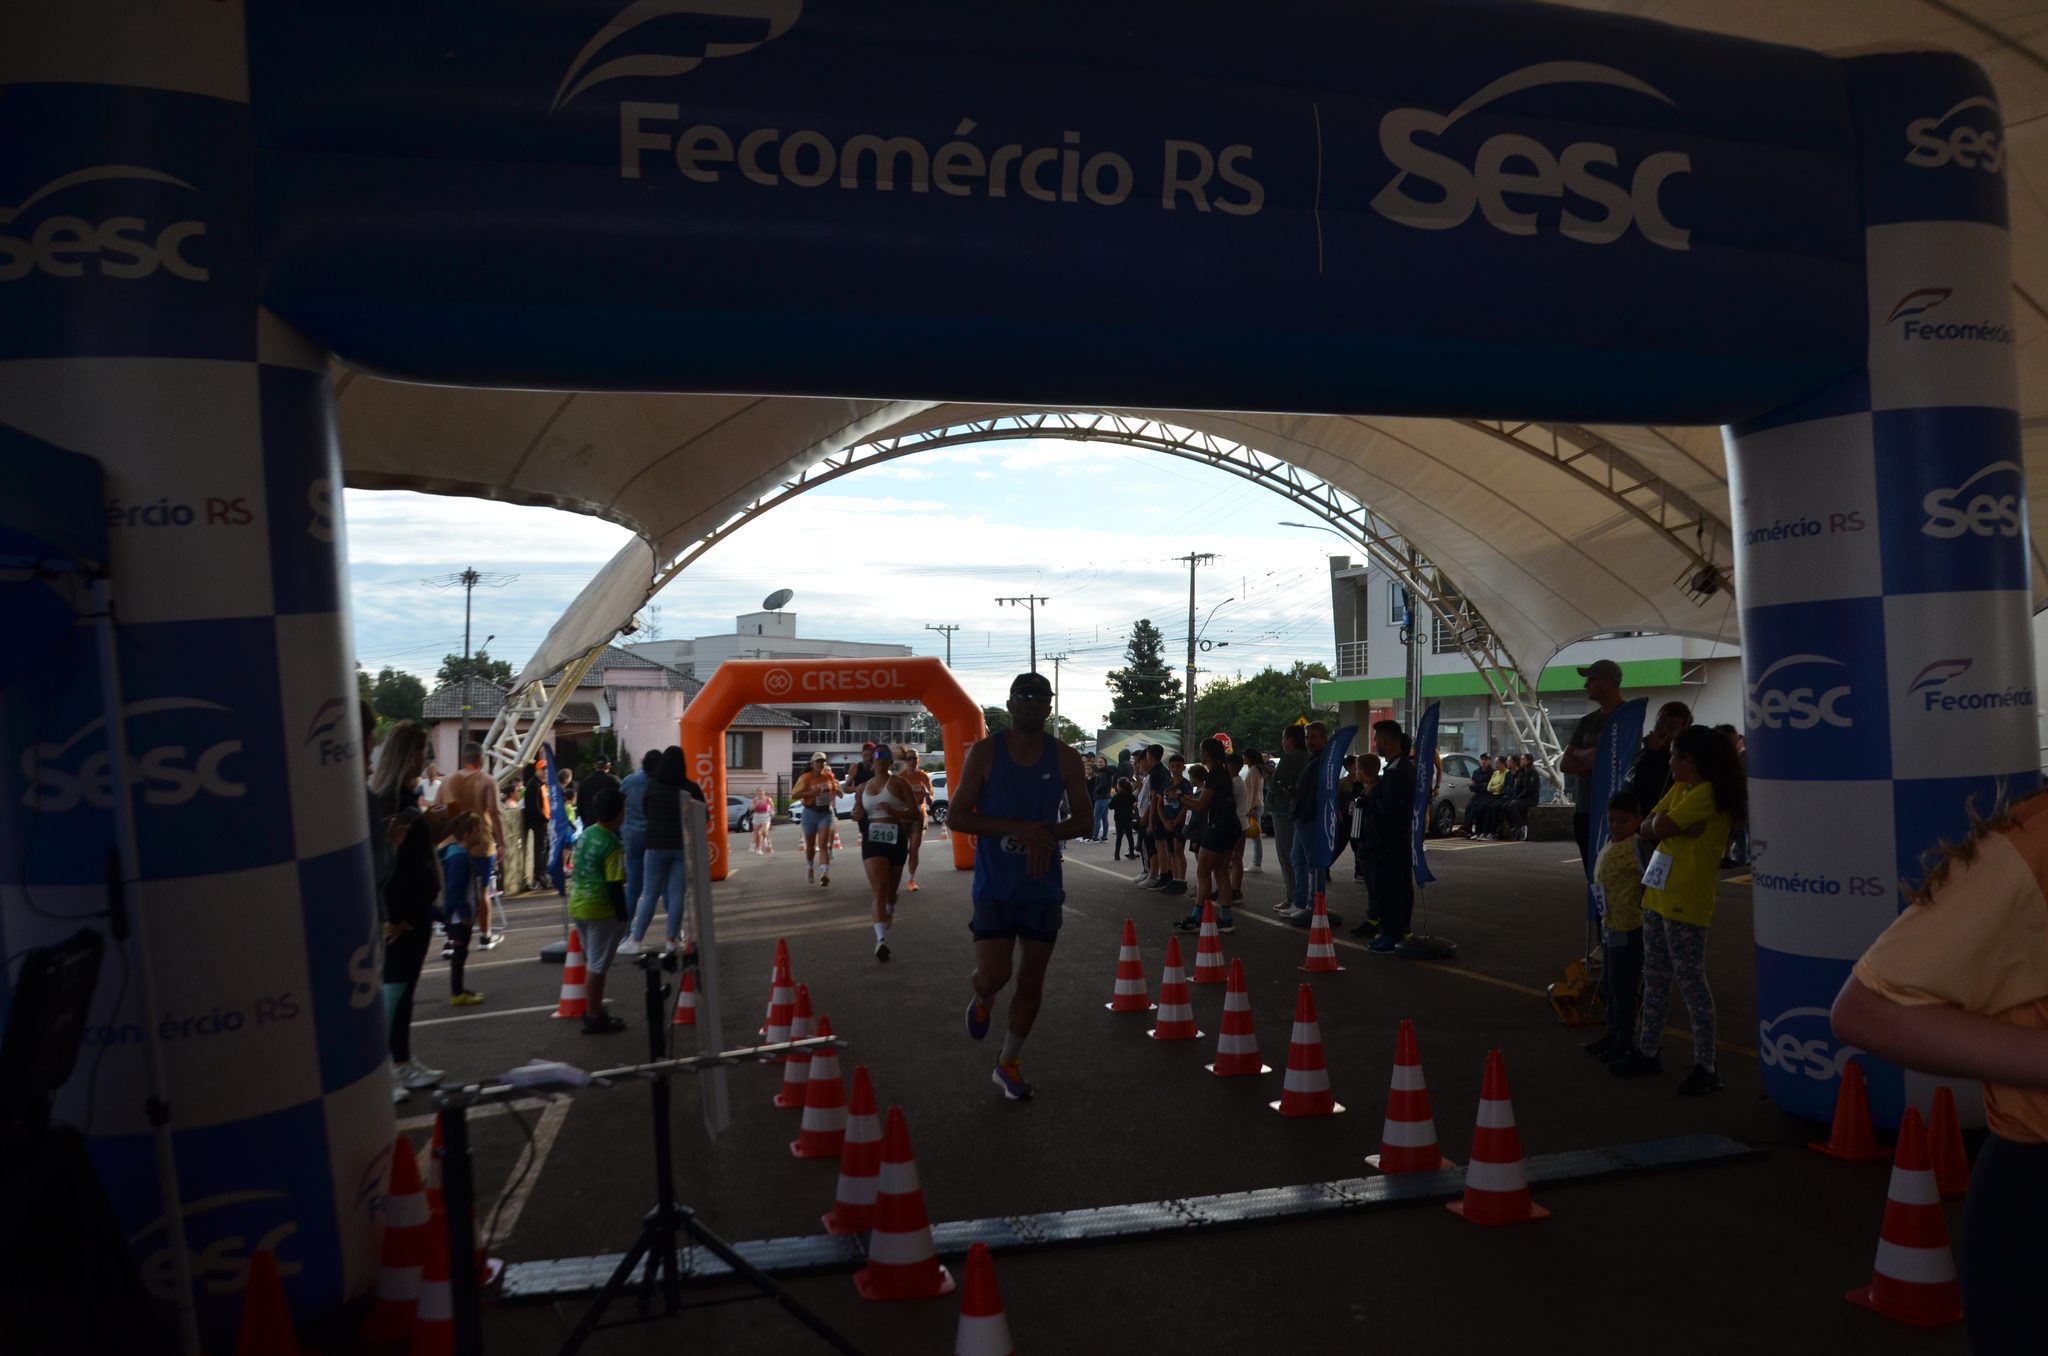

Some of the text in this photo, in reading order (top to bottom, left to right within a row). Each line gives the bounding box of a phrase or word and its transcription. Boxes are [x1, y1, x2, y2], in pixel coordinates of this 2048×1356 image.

[618, 101, 1265, 216] Fecomércio RS
[1369, 106, 1692, 251] Sesc
[207, 498, 253, 526] RS
[1829, 511, 1866, 534] RS
[801, 668, 906, 691] CRESOL
[872, 830, 894, 842] 219
[1754, 871, 1885, 896] ecomércio RS
[255, 992, 300, 1025] RS
